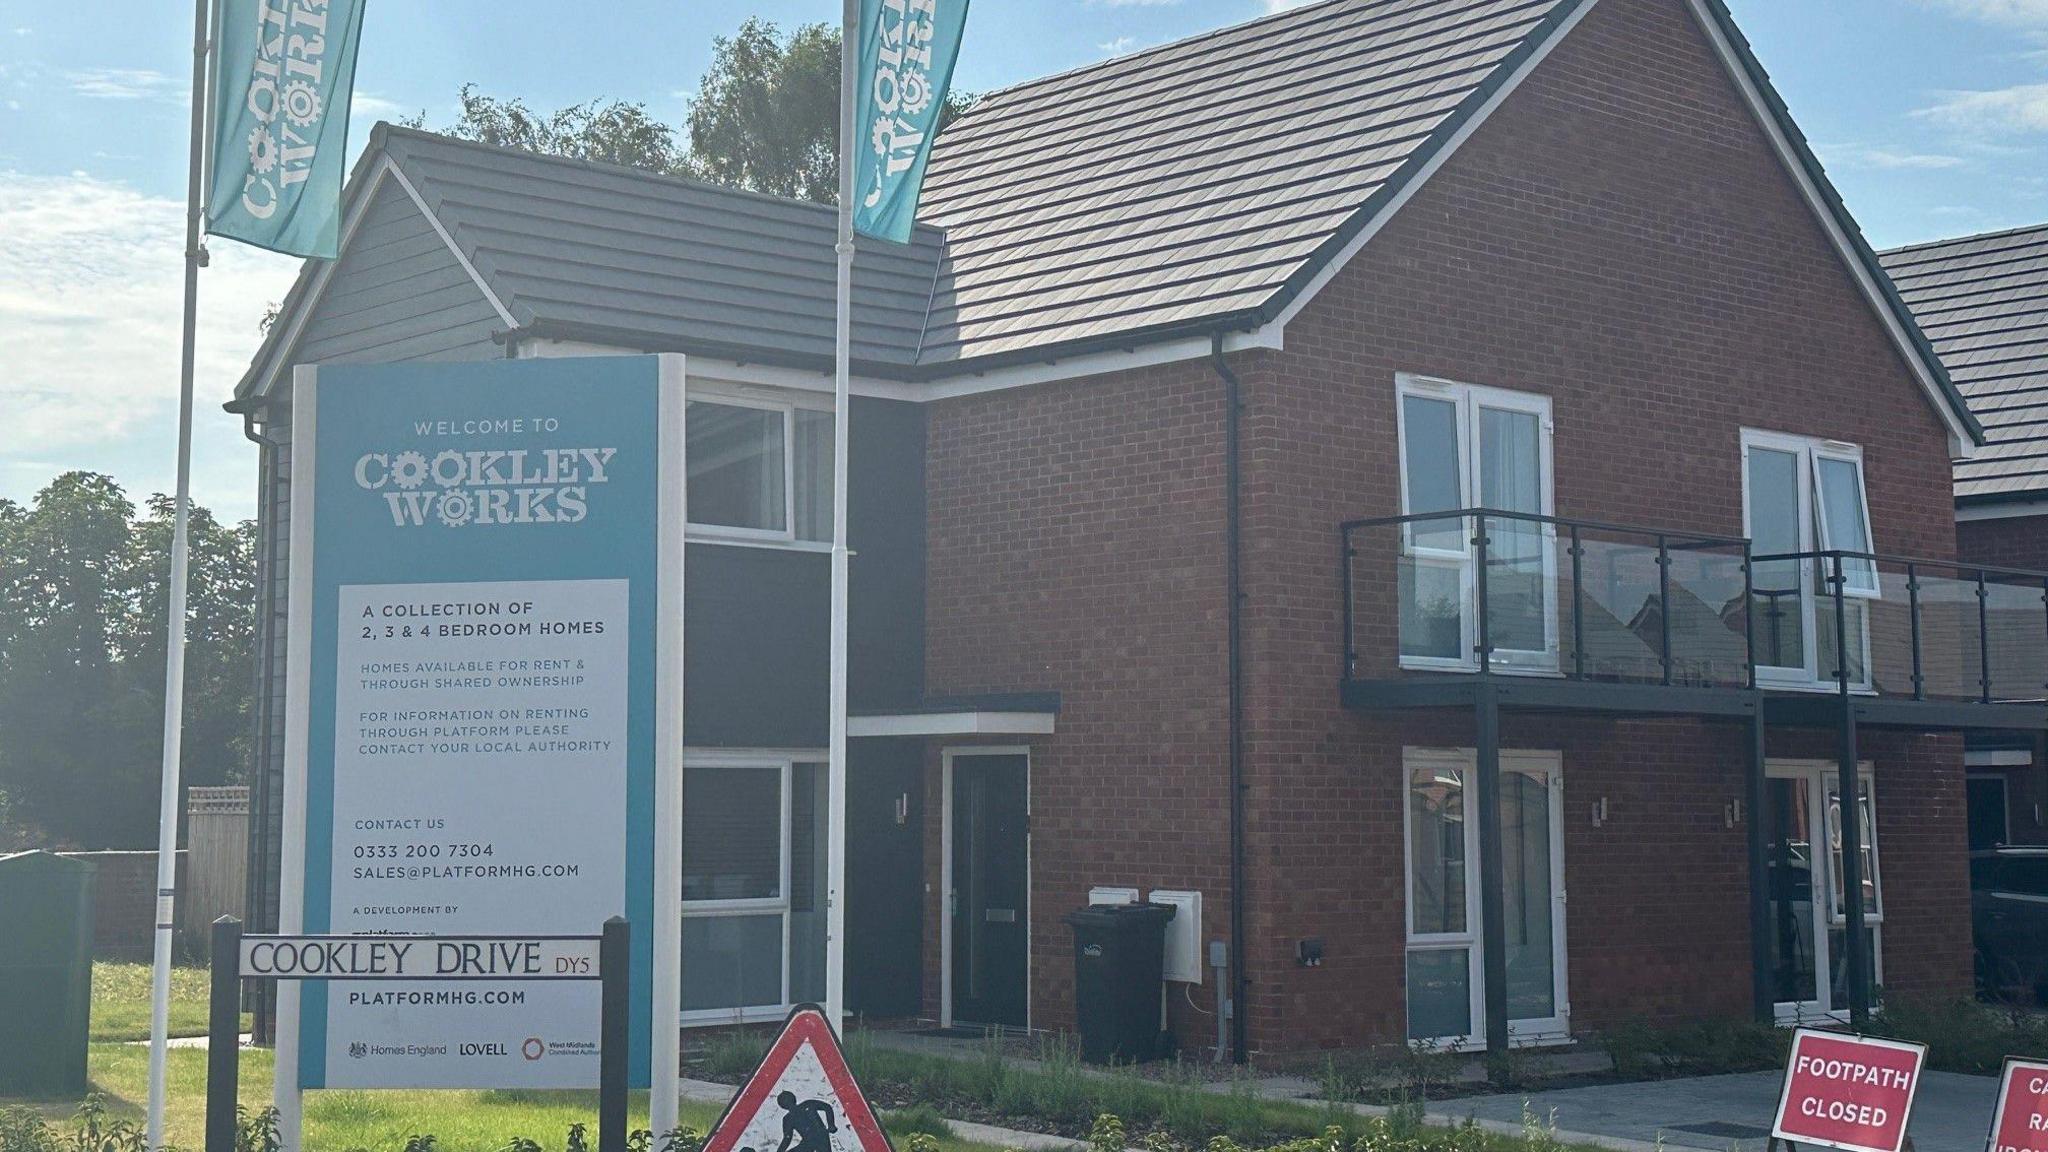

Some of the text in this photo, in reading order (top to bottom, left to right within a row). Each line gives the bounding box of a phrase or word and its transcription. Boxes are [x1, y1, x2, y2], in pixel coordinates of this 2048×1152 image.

[414, 418, 560, 436] WELCOME TO
[354, 447, 618, 490] COOKLEY
[383, 486, 588, 528] WORKS
[362, 601, 534, 618] A COLLECTION OF
[361, 621, 605, 641] 2, 3 & 4 BEDROOM HOMES
[360, 658, 585, 674] HOMES AVAILABLE FOR RENT &
[360, 675, 585, 690] THROUGH SHARED OWNERSHIP
[359, 708, 590, 723] FOR INFORMATION ON RENTING
[359, 724, 569, 739] THROUGH PLATFORM PLEASE
[358, 739, 611, 755] CONTACT YOUR LOCAL AUTHORITY
[354, 818, 445, 831] CONTACT US
[353, 843, 494, 859] 0333 200 7304
[353, 864, 580, 881] SALES@PLATFORMHG.COM
[353, 904, 458, 915] A DEVELOPMENT BY
[249, 941, 590, 975] COOKLEY DRIVE DY5
[349, 991, 526, 1006] PLATFORMHG.COM
[370, 1043, 448, 1057] Homes England
[459, 1042, 508, 1057] LOVELL
[1797, 1055, 1911, 1091] FOOTPATH
[1801, 1096, 1887, 1127] CLOSED
